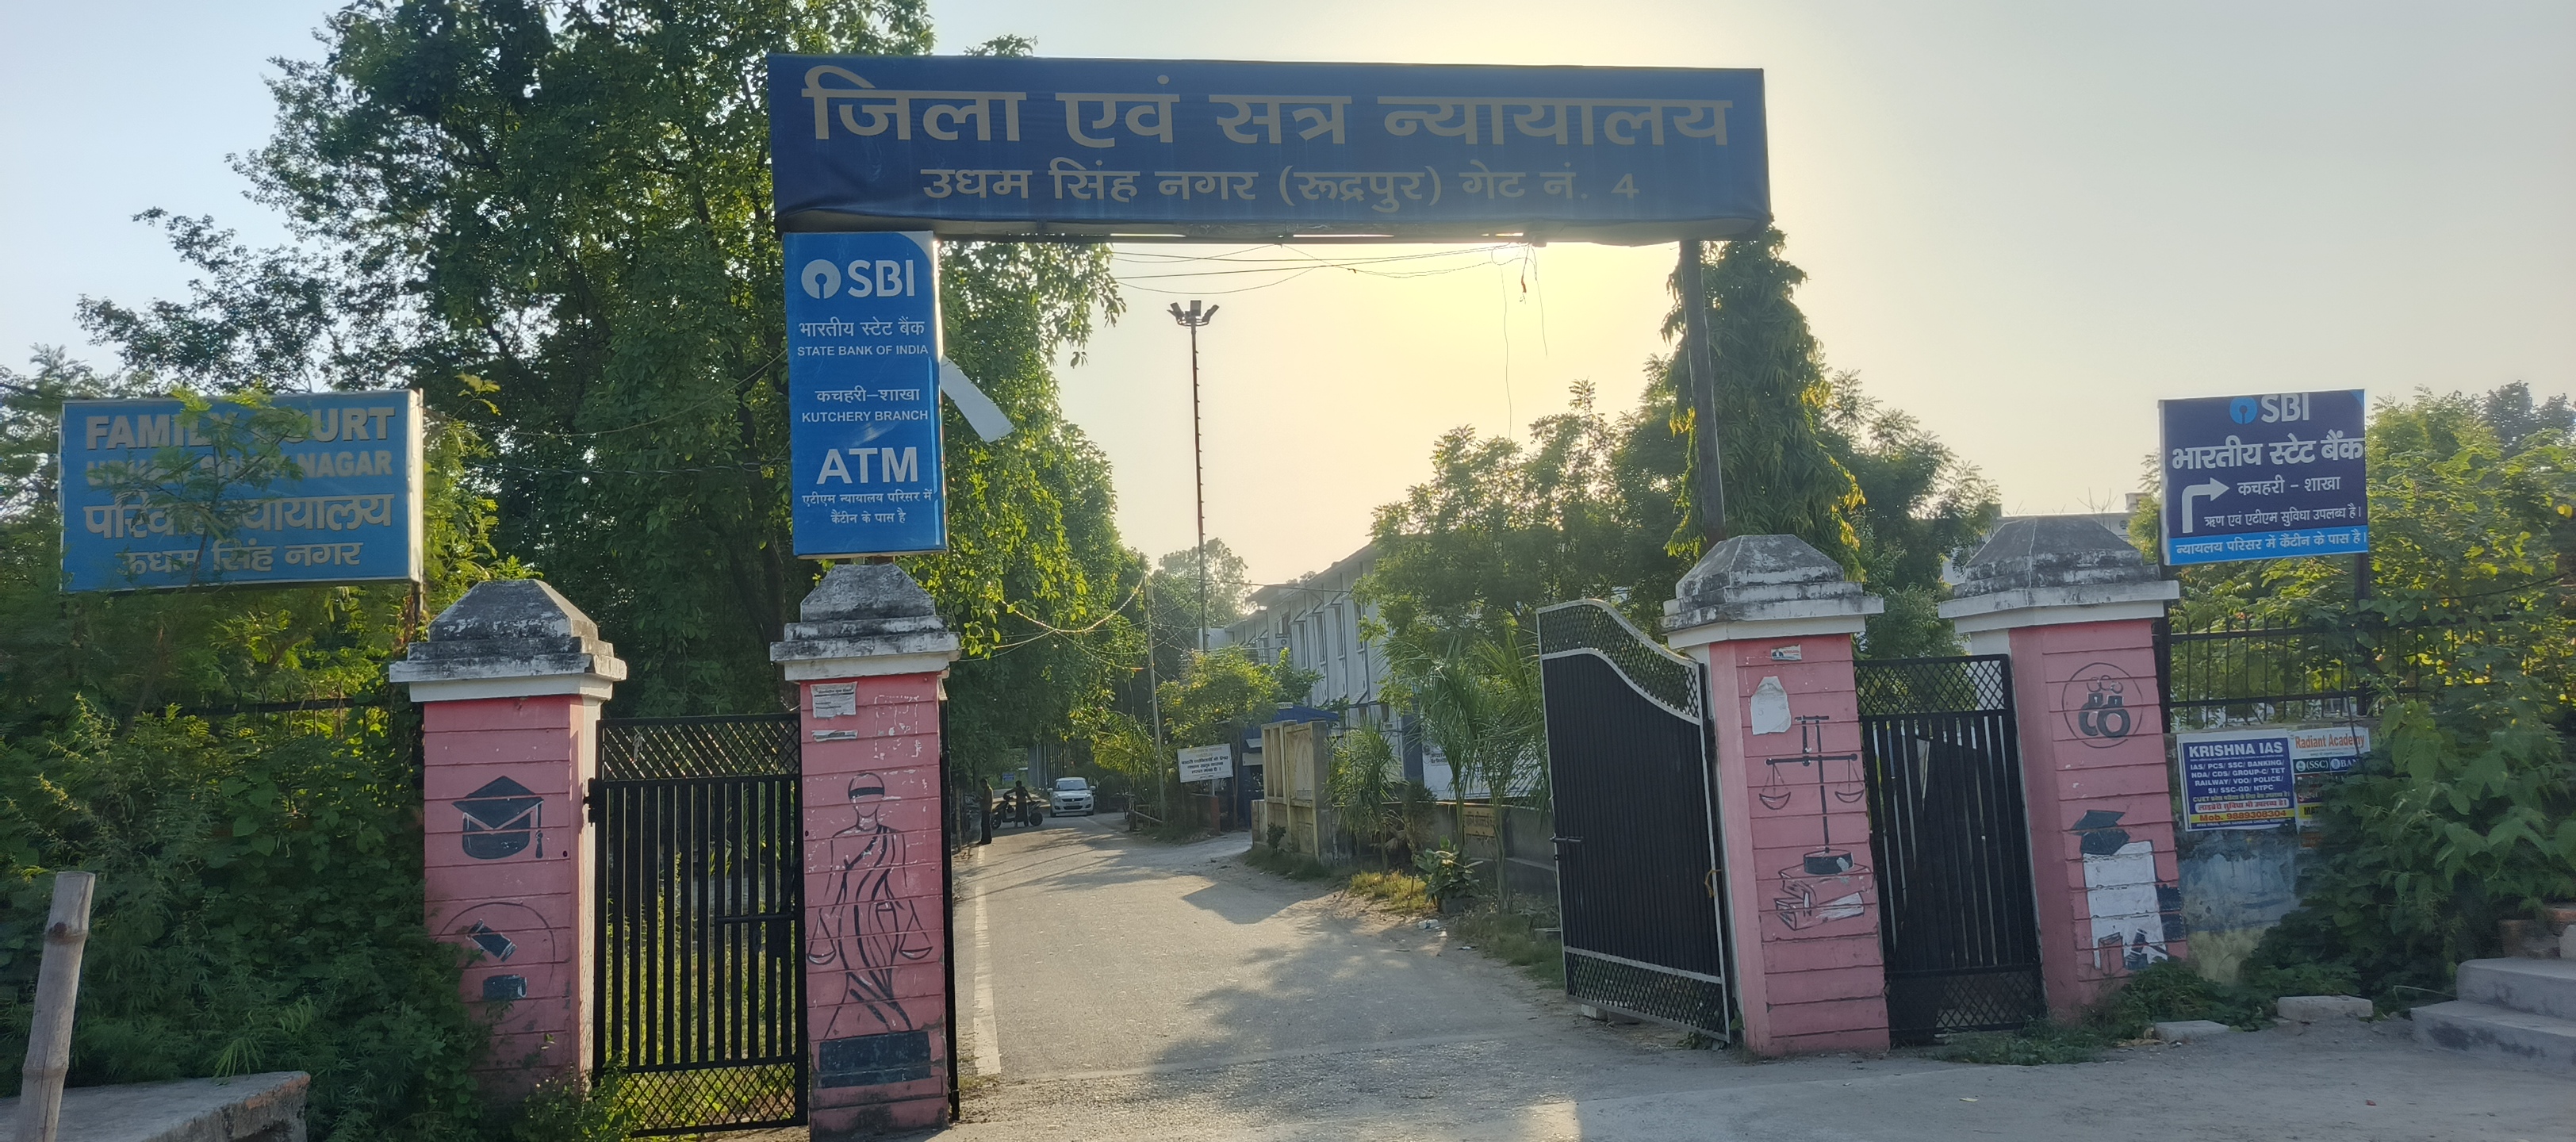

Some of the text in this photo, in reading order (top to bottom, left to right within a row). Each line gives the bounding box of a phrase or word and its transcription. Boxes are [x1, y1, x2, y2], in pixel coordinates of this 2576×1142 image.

[802, 65, 1733, 148] जिला एवं सत्र न्यायालय
[921, 169, 1032, 199] उधम
[1048, 157, 1140, 203] सिंह
[1155, 171, 1259, 201] नगर
[1459, 159, 1525, 199] गेट
[1540, 162, 1587, 199] नं.
[1611, 174, 1639, 199] 4
[848, 259, 914, 298] SBI
[799, 316, 926, 337] भारतीय स्टेट बैंक
[797, 344, 929, 356] STATE BANK OF INDIA
[802, 410, 929, 423] KUTCHERY BRANCH
[2260, 393, 2310, 423] SBI
[251, 407, 395, 444] URT
[2172, 429, 2366, 469] भारतीय स्टेट बैंक
[297, 450, 393, 478] NAGAR
[816, 446, 918, 485] ATM
[2237, 474, 2285, 496] कचहरी
[2304, 476, 2341, 491] शाखा
[802, 489, 932, 507] एटीएम न्यायालय परिसर में
[82, 489, 206, 539] परिव
[830, 507, 906, 523] कैंटीन के पास है
[2203, 515, 2225, 527] ऋण
[2227, 510, 2242, 527] एवं
[2244, 508, 2278, 526] एटीएम
[2175, 542, 2223, 554] न्यायलय
[2225, 536, 2262, 551] परिसर
[2265, 535, 2276, 548] में
[2279, 533, 2310, 547] कैंटीन
[2313, 531, 2325, 546] के
[2327, 533, 2350, 545] पास
[211, 538, 277, 573] सिंह
[284, 542, 364, 566] नगर
[2189, 743, 2256, 758] KRISHNA
[2259, 741, 2283, 754] IAS
[2294, 733, 2365, 749] Radiant Academy
[2232, 768, 2268, 776] GROUP-C/
[2247, 759, 2284, 768] BANKING/
[2306, 760, 2329, 770] (SSC)
[2195, 778, 2231, 787] RAILWAY/
[2226, 810, 2287, 820] 9889308304
